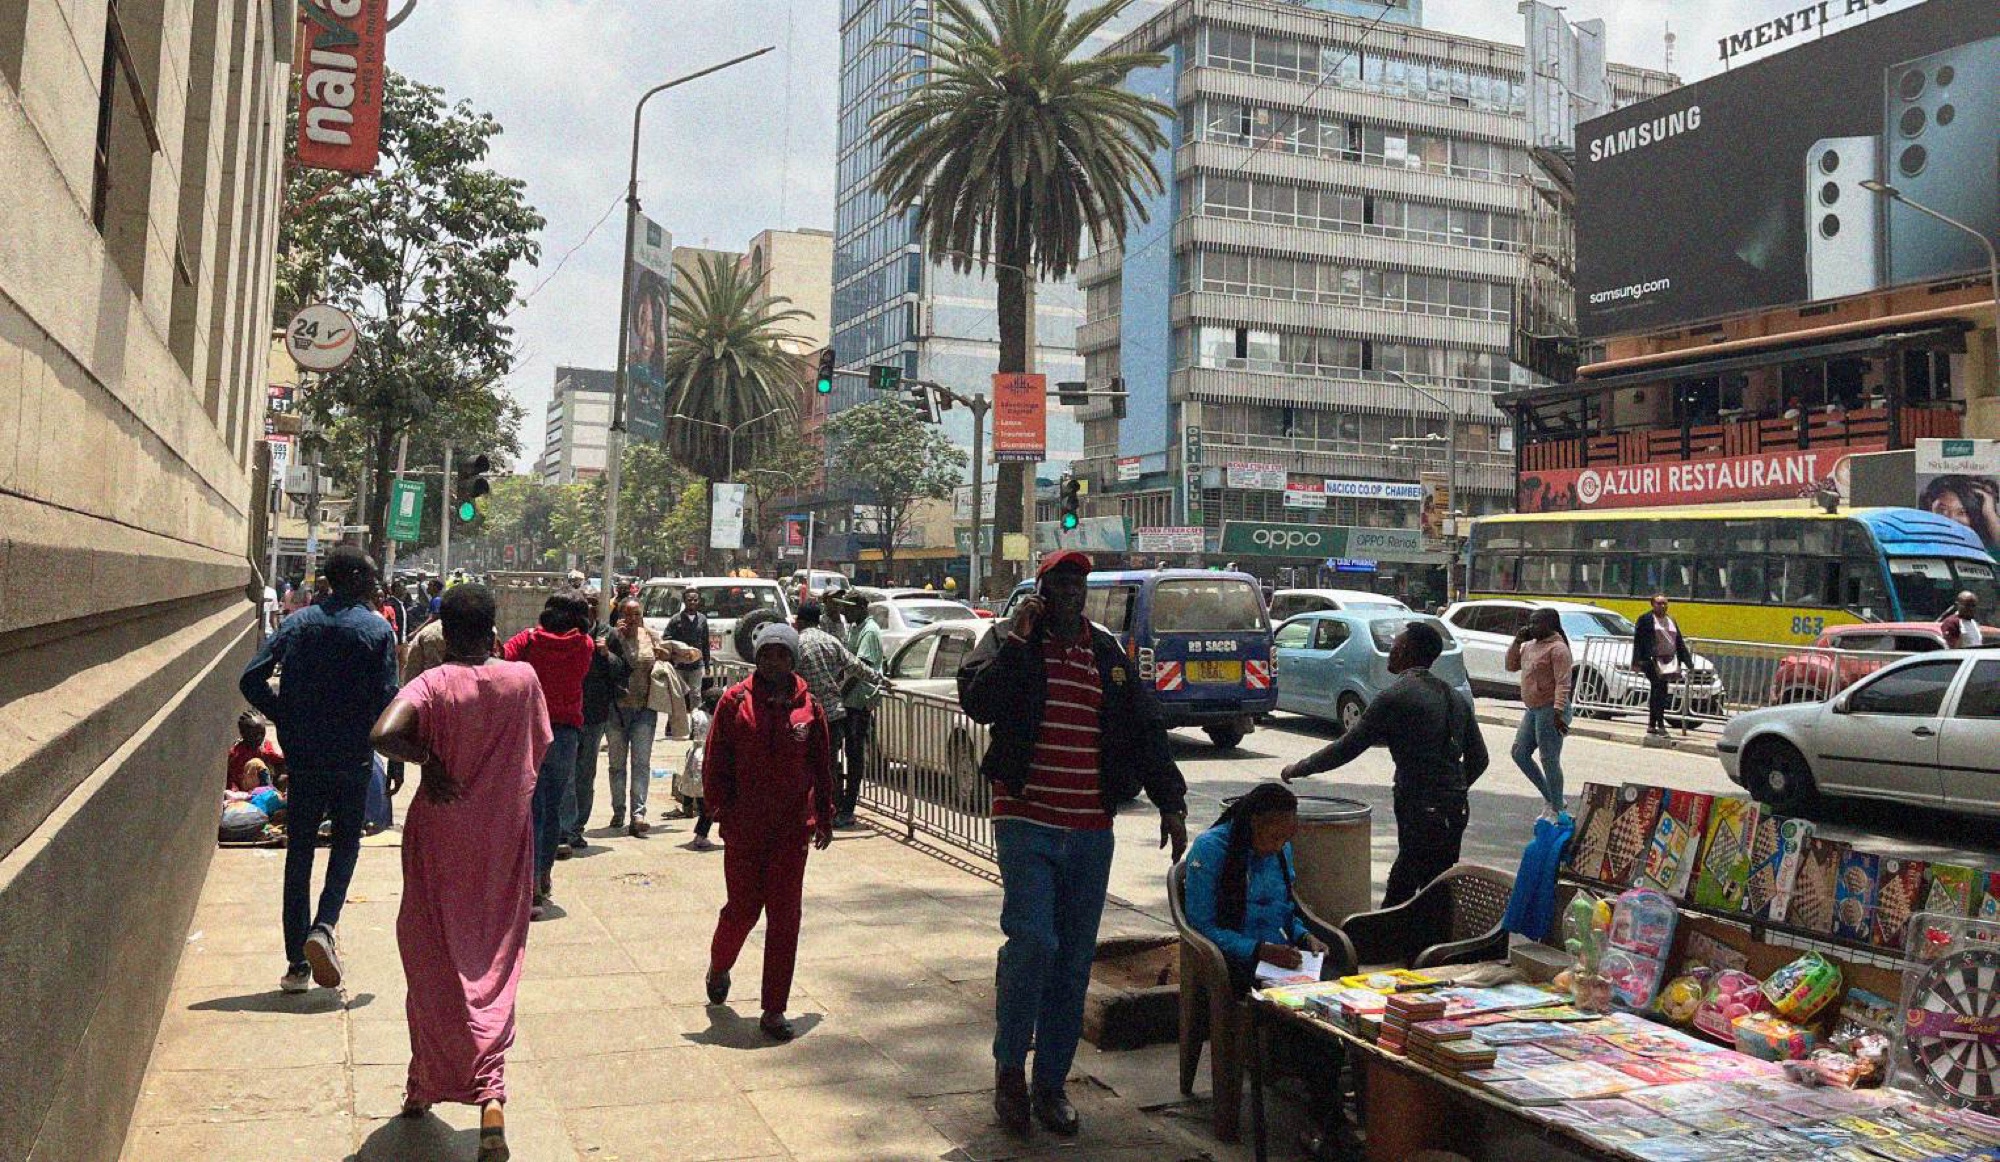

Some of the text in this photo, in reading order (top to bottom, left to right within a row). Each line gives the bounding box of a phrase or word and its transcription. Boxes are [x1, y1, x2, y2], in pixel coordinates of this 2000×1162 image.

[1718, 1, 1829, 60] IMENTI
[1589, 105, 1701, 162] SAMSUNG
[1589, 278, 1670, 304] samsung.com
[294, 318, 319, 338] 24
[1602, 454, 1817, 496] AZURI RESTAURANT
[1252, 529, 1321, 551] oppo
[1356, 534, 1384, 546] OPPO
[1791, 615, 1824, 636] 863
